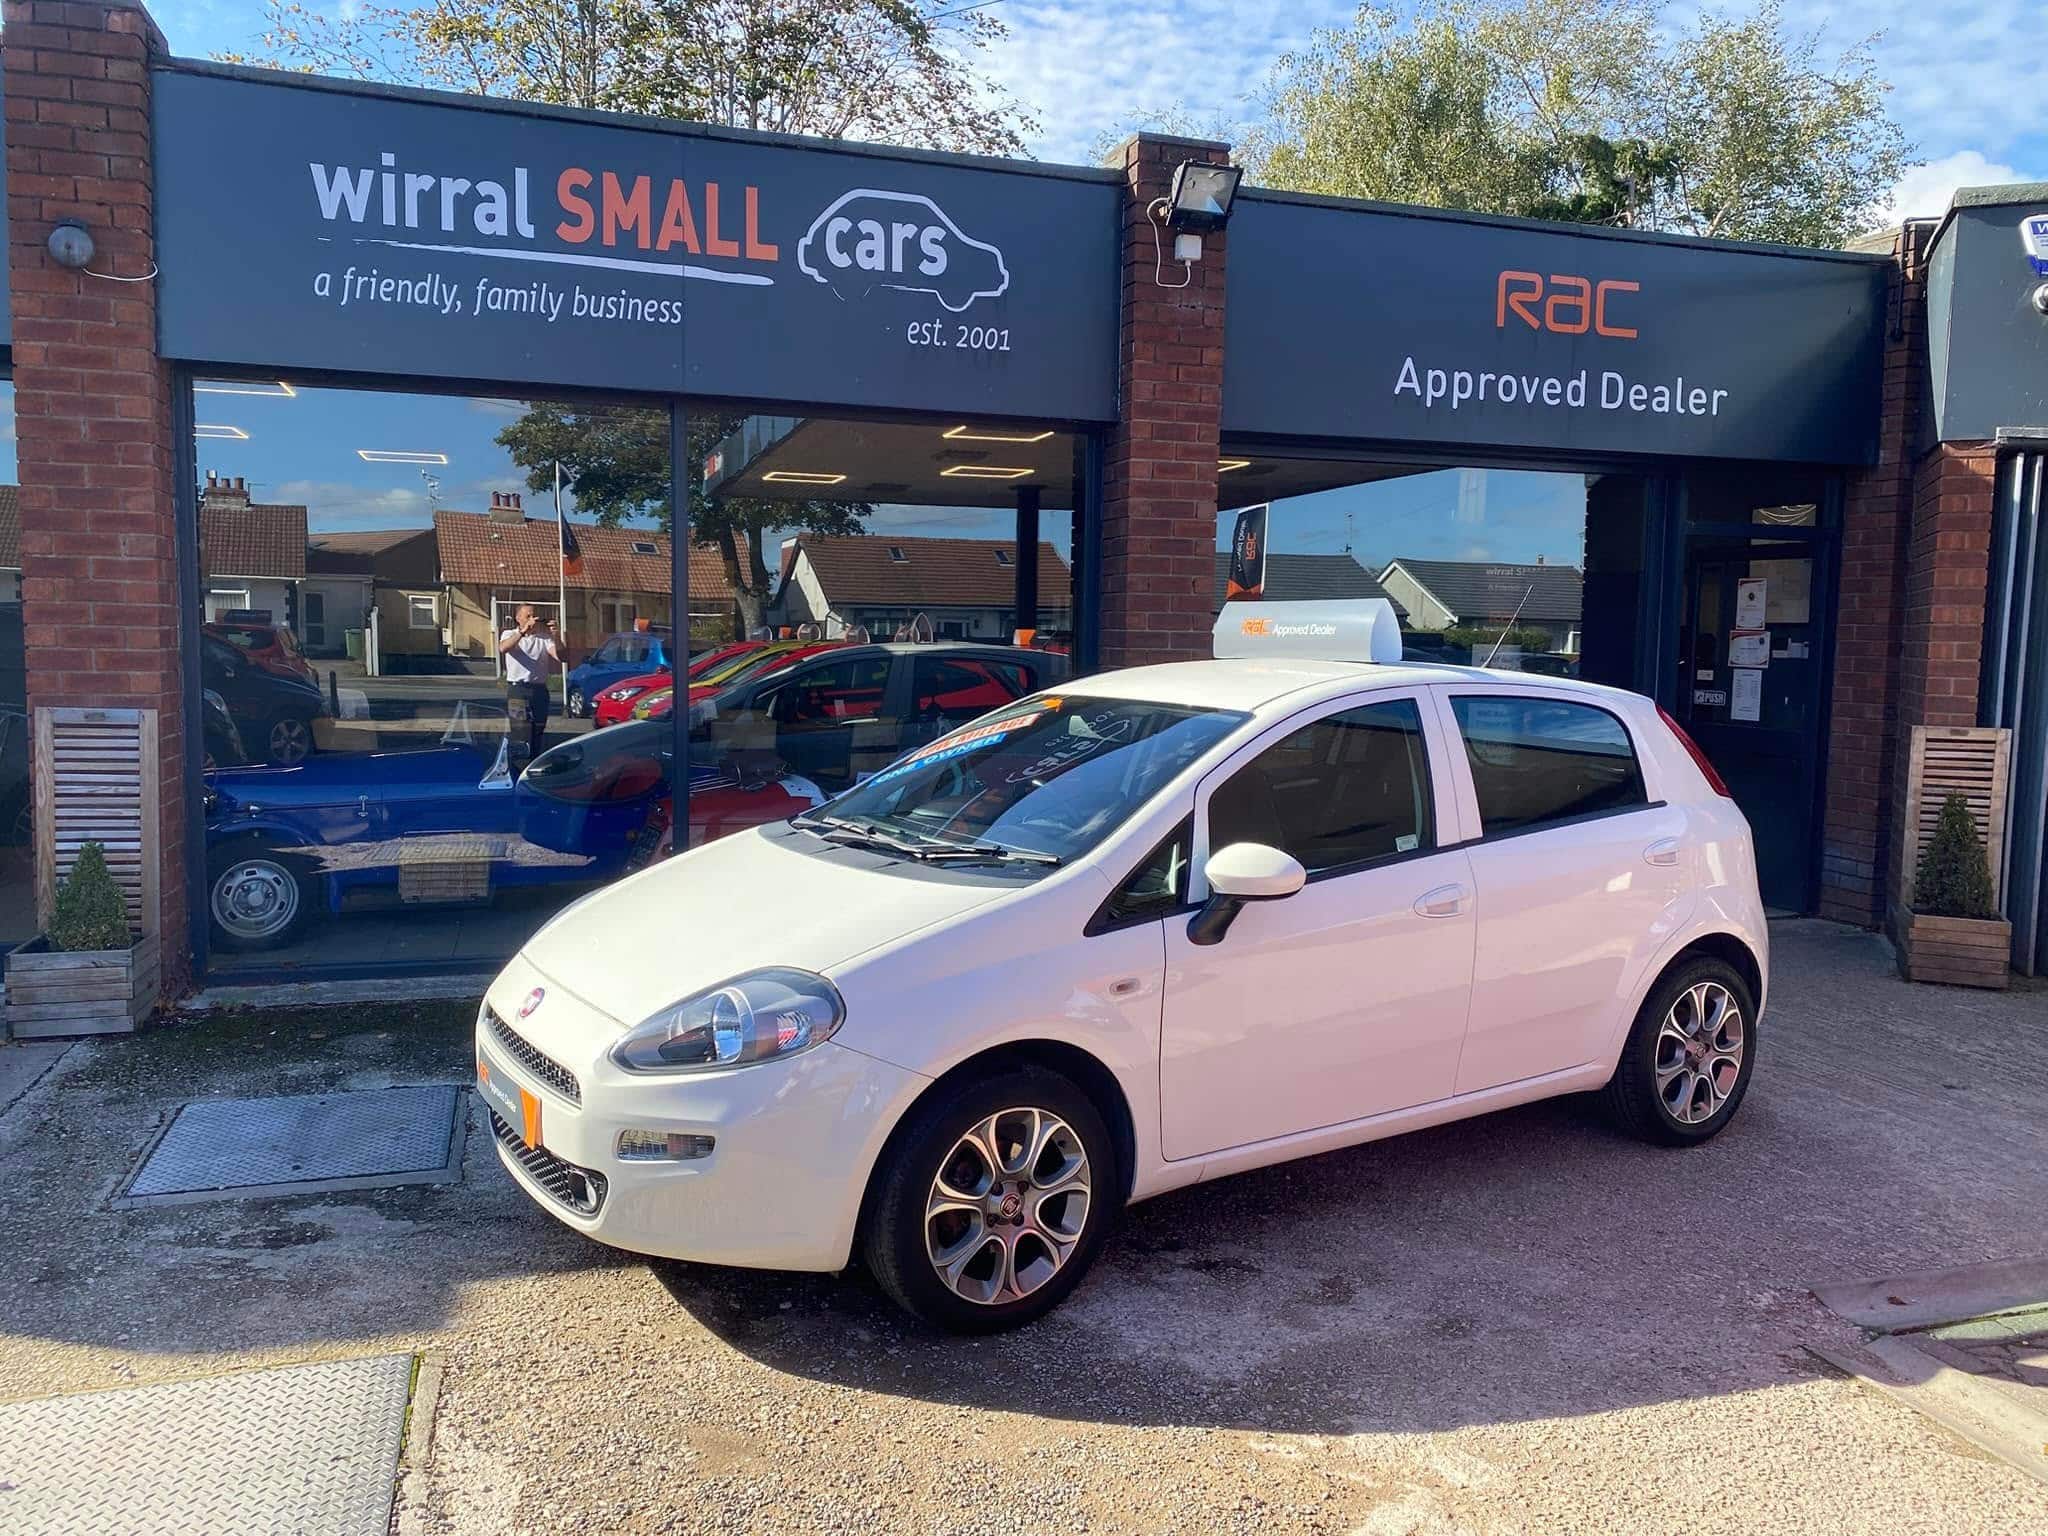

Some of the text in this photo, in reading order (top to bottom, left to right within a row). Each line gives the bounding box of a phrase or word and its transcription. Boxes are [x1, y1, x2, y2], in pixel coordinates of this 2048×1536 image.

[309, 152, 949, 277] wirral SMALL cars
[313, 267, 683, 324] a friendly, family business
[907, 319, 1011, 352] est. 2001
[1393, 356, 1729, 416] Approved Dealer
[1271, 624, 1310, 637] Approved
[1310, 623, 1336, 635] Dealer
